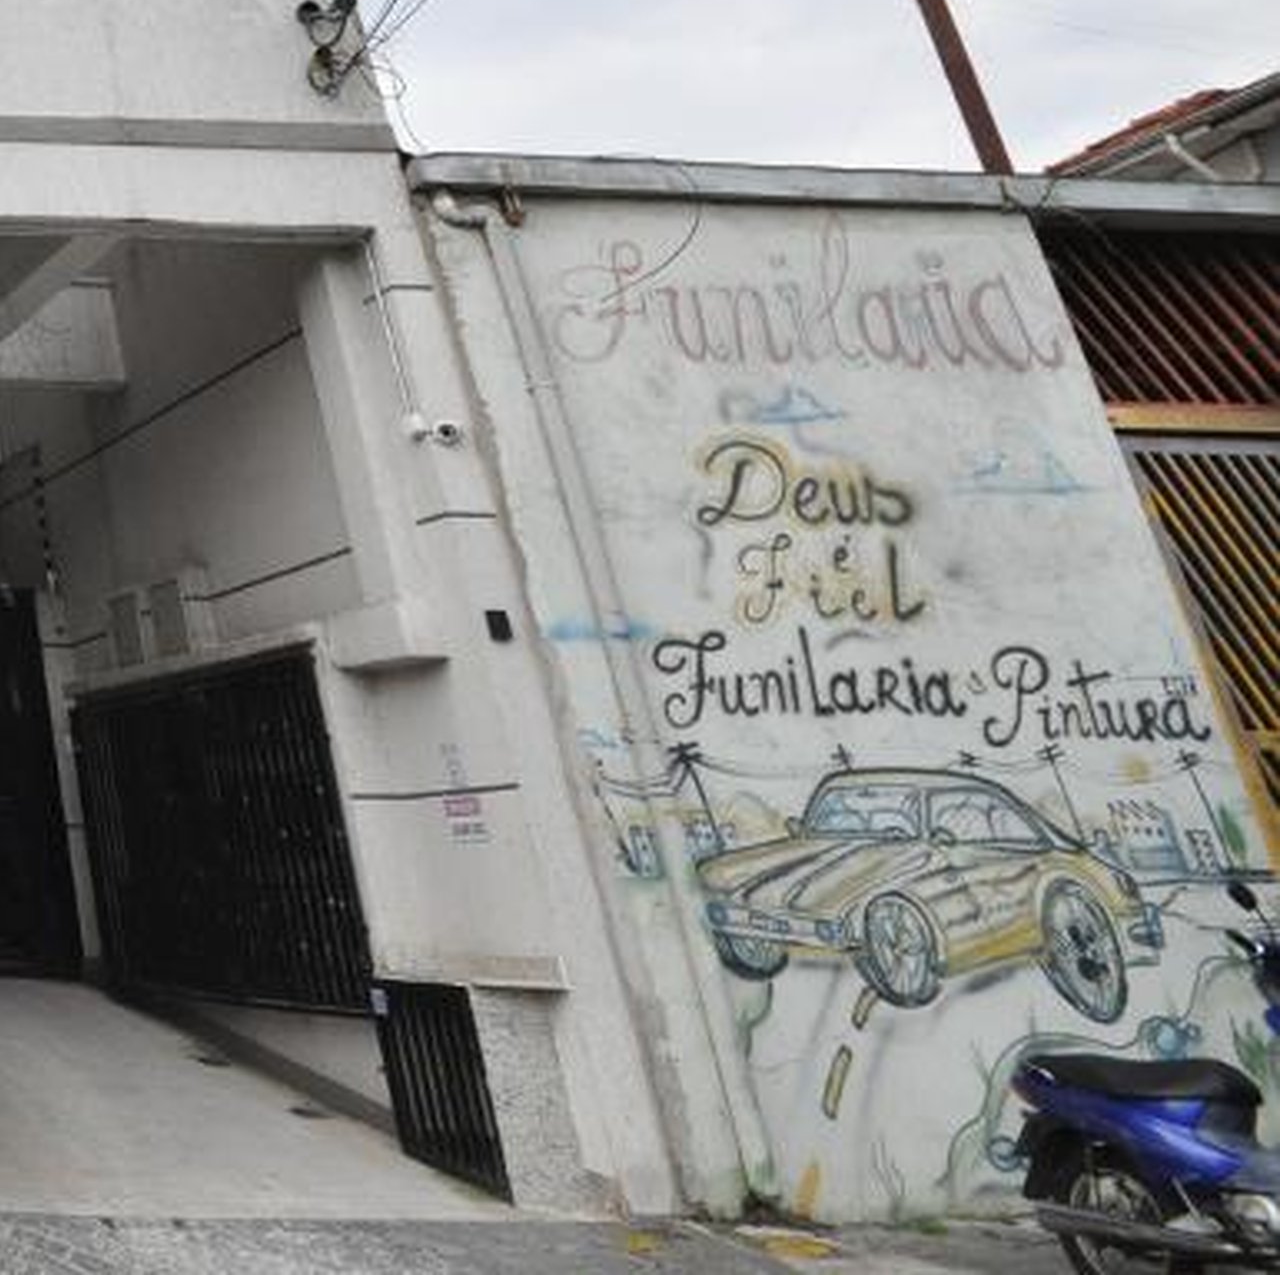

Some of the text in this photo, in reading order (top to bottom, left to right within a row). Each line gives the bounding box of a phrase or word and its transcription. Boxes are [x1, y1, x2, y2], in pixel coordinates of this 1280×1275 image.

[697, 440, 914, 525] Deus
[652, 626, 968, 729] Funilaria
[983, 645, 1212, 748] Pintura
